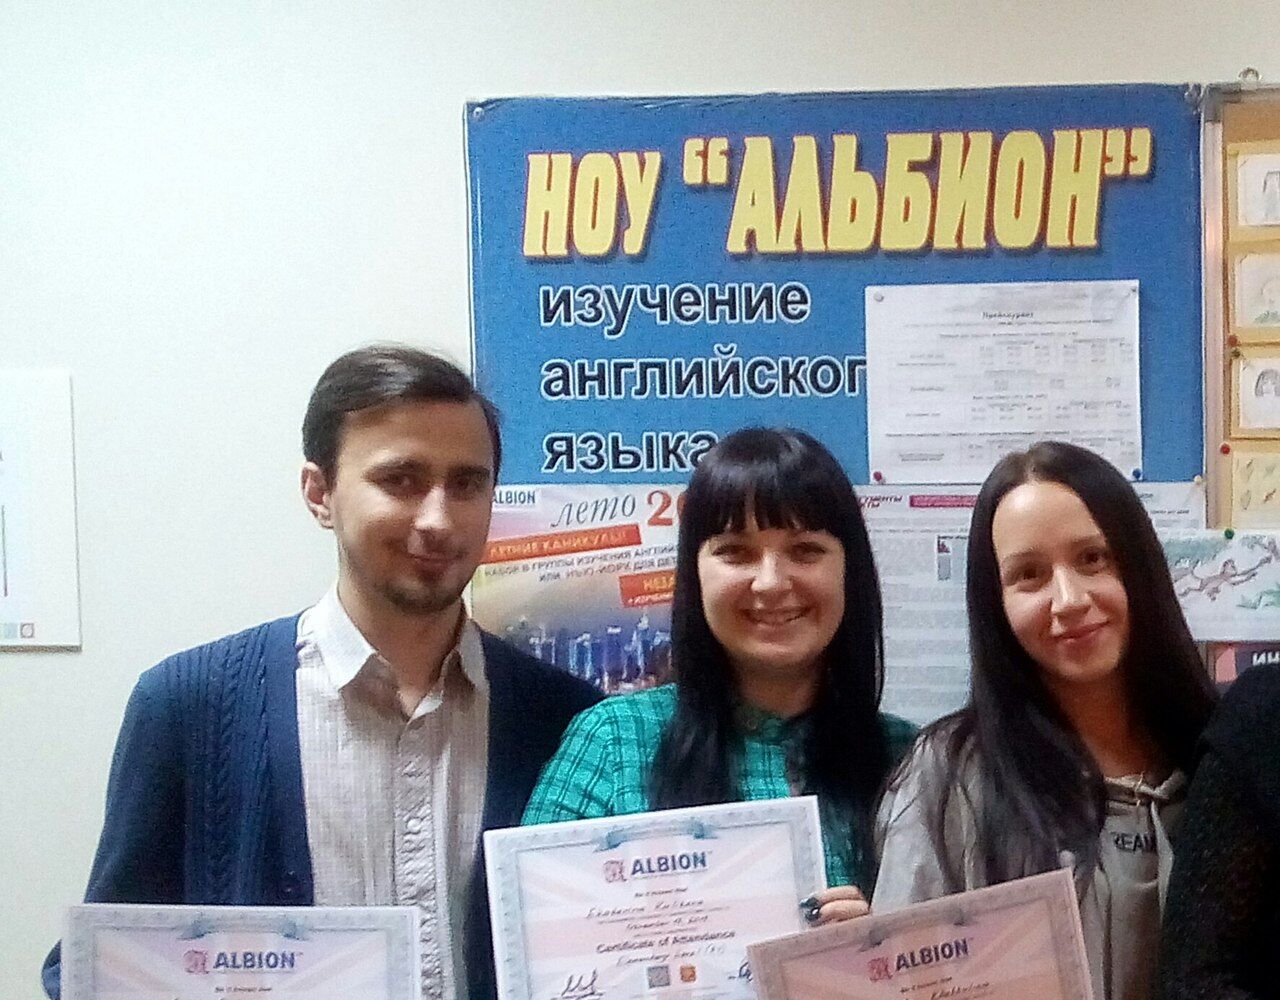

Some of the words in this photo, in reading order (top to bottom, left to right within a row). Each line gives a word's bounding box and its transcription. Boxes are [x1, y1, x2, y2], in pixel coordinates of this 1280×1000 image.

[522, 151, 661, 256] НОУ
[539, 282, 811, 337] изучение
[550, 494, 636, 528] лето
[631, 851, 708, 876] ALBION
[212, 951, 295, 969] ALBION
[895, 938, 969, 972] ALBION
